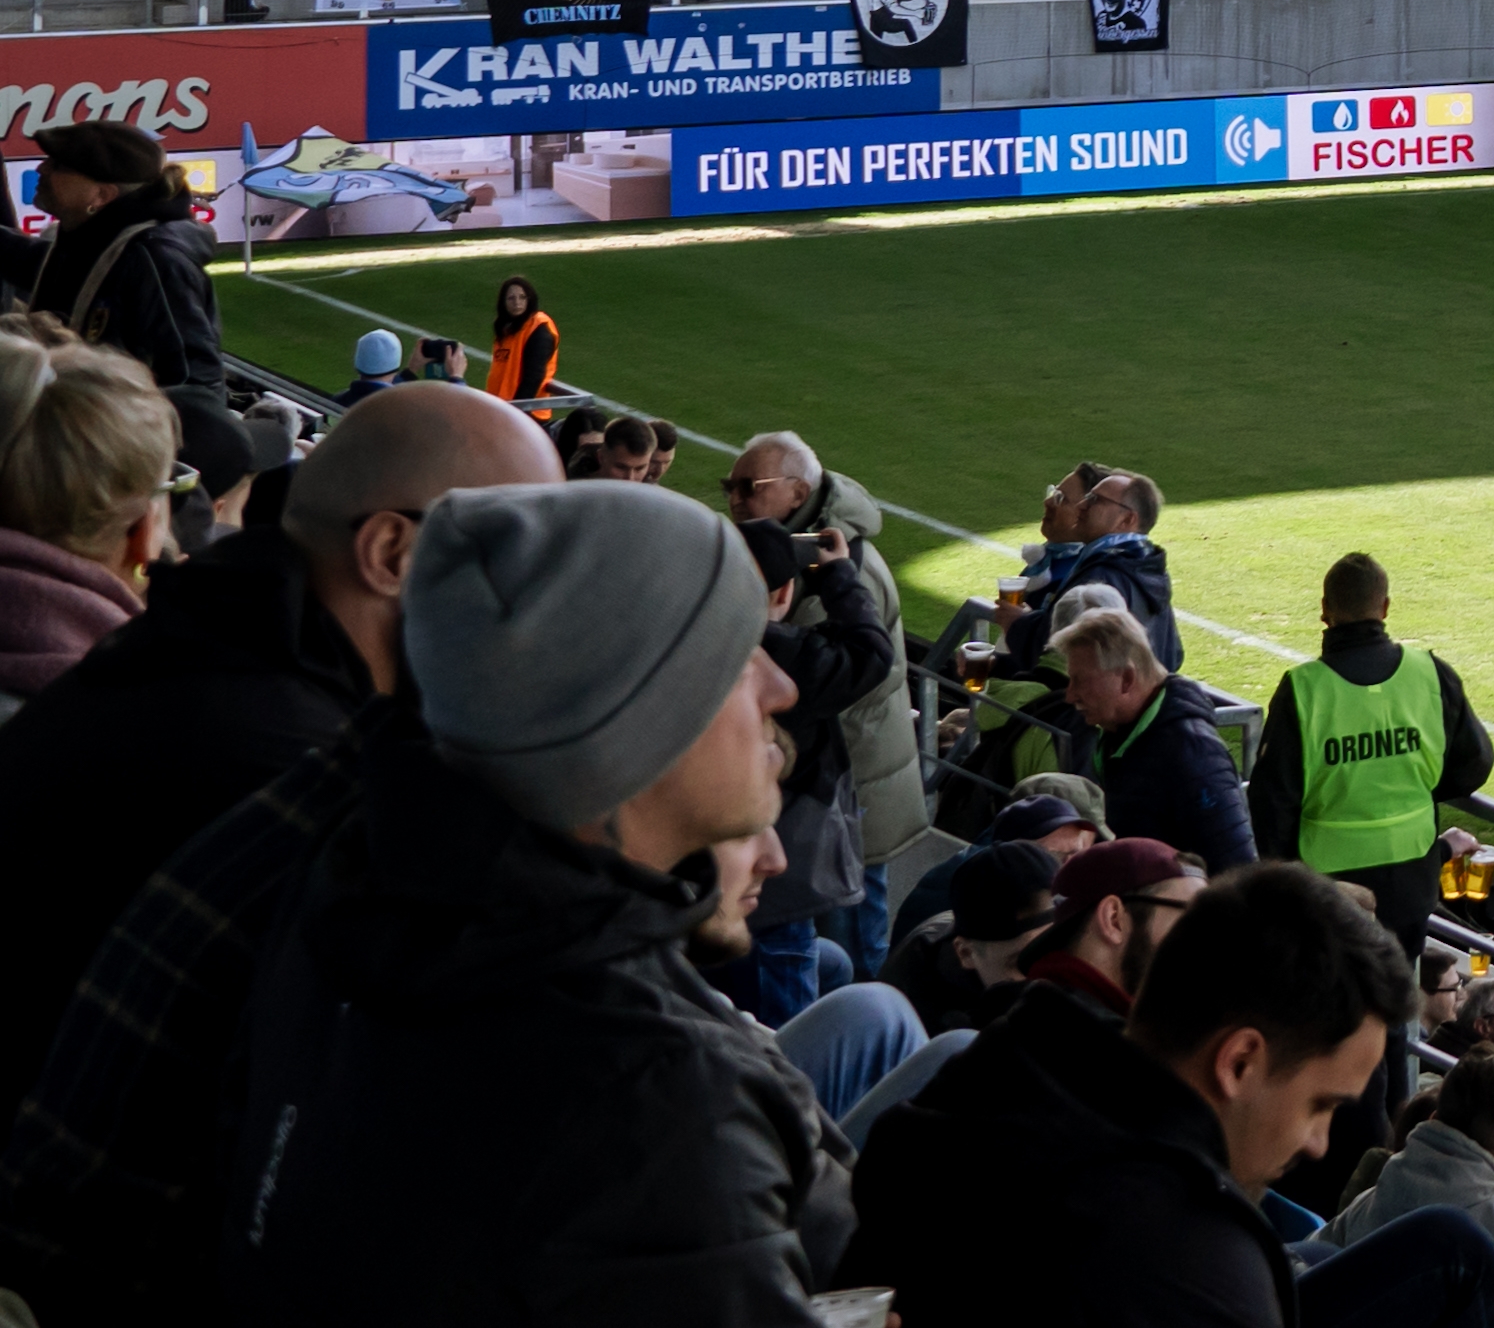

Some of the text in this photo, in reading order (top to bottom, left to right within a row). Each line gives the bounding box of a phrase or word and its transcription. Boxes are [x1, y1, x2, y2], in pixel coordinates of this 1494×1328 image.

[524, 2, 622, 26] CHEMNITZ
[399, 30, 862, 110] KRAN WALTHE
[567, 67, 912, 102] KRAN- UND TRANSPORTBETRIEB
[698, 127, 1188, 194] FÜR DEN PERFEKTEN SOUND
[1313, 133, 1475, 174] FISCHER
[1324, 726, 1421, 766] ORDNER
